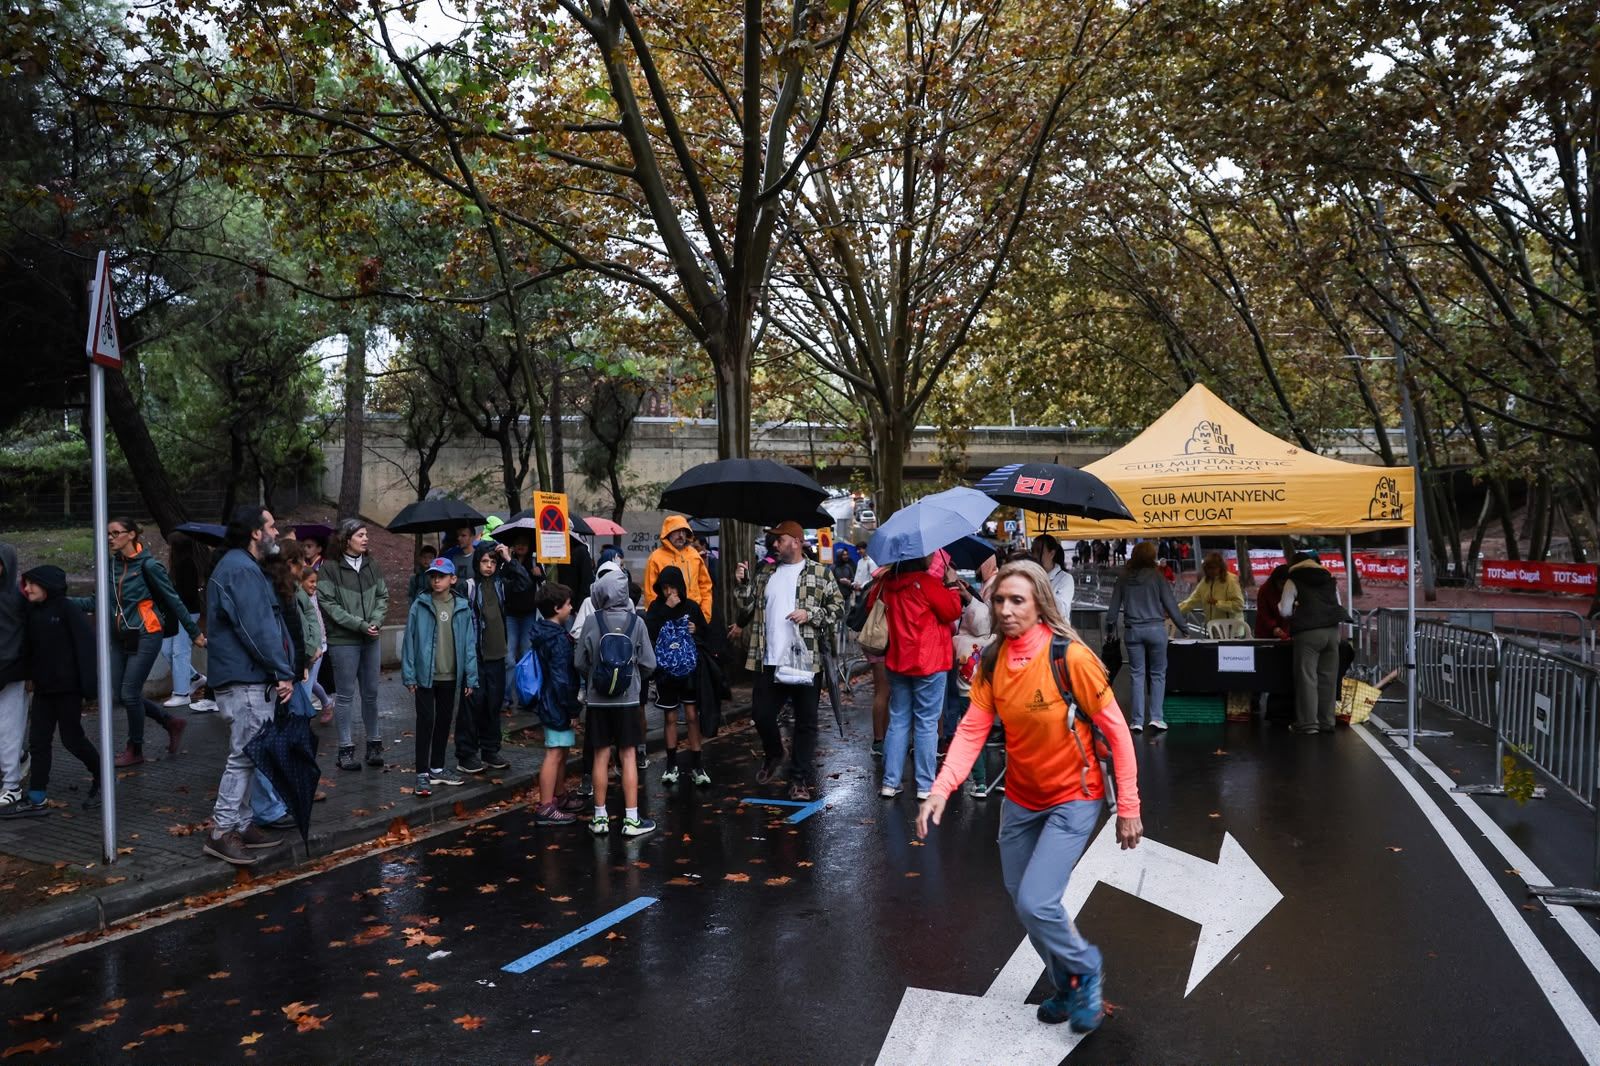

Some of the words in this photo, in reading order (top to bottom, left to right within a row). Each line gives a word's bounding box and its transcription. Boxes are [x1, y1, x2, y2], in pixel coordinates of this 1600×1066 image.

[1125, 462, 1165, 471] CLUB
[1169, 457, 1294, 467] MUNTANYENC
[1154, 466, 1197, 474] SANT
[1014, 474, 1055, 496] 20
[1142, 493, 1177, 506] CLUB
[1180, 489, 1286, 504] MUNTANYENC
[1143, 509, 1181, 524] SANT
[1184, 507, 1234, 522] CUGAT
[1519, 569, 1540, 583] Cugat
